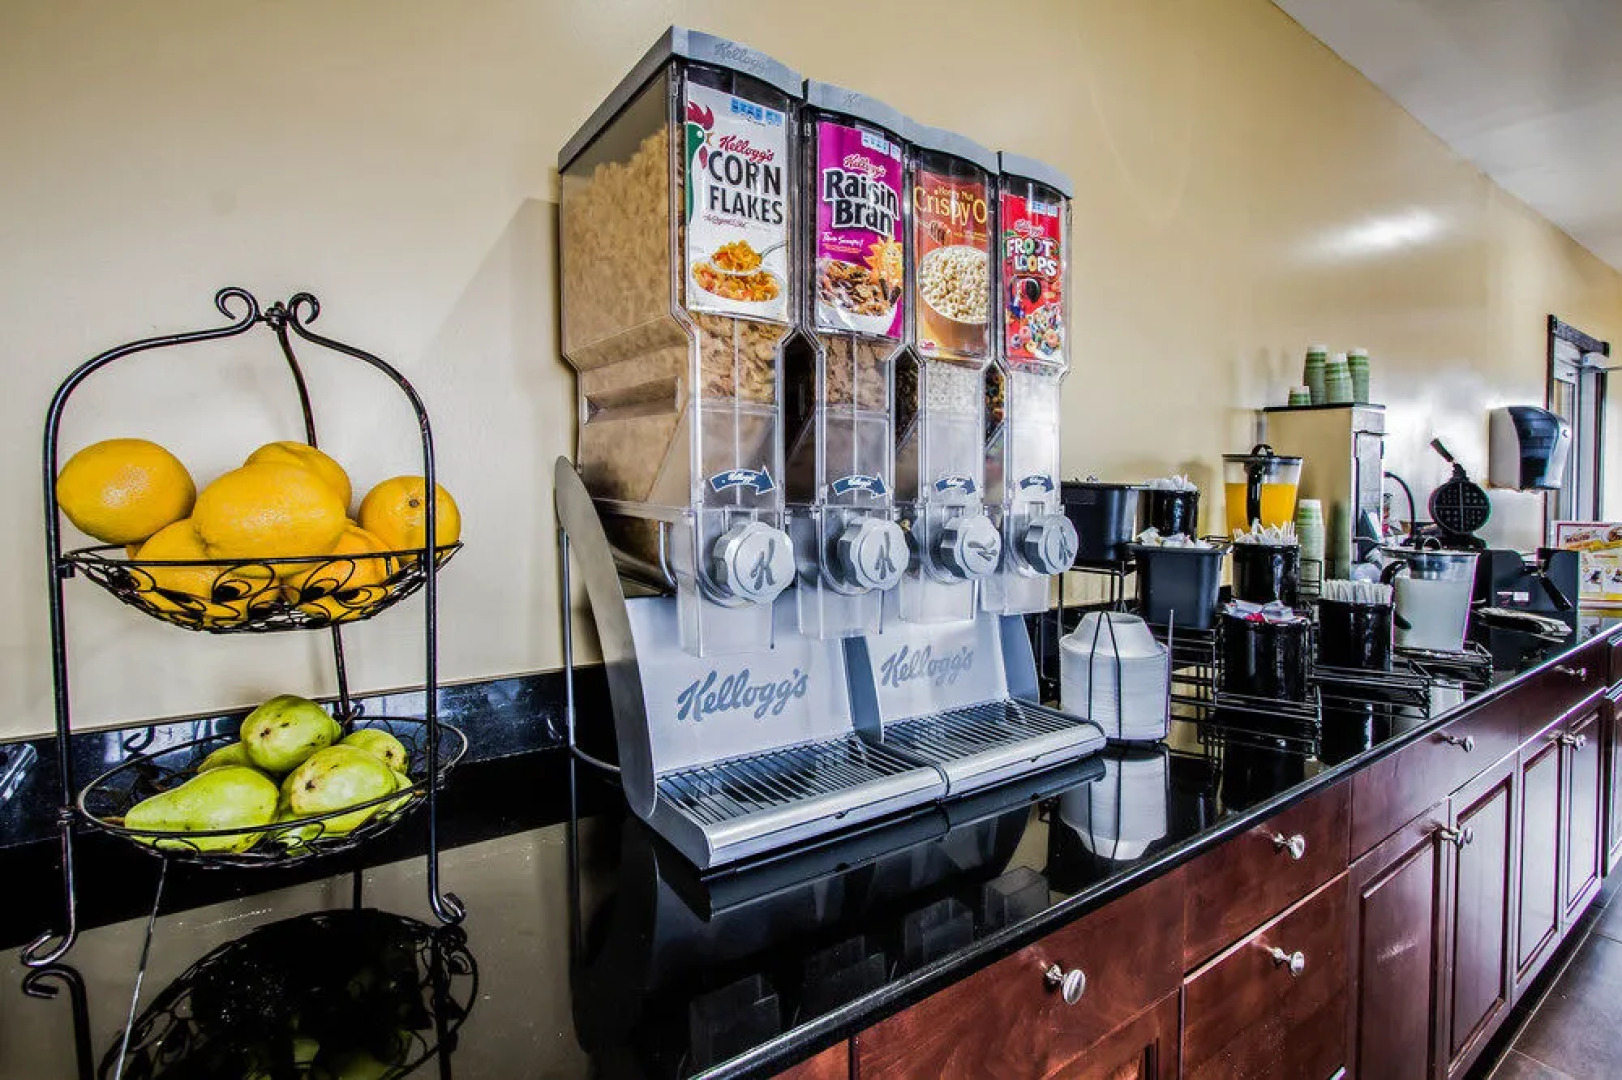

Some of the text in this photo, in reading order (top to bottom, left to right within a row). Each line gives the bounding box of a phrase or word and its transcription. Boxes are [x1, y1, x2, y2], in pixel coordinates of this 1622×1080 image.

[719, 135, 775, 164] Kellogg's
[708, 150, 782, 196] CORN
[709, 184, 783, 225] FLAKES
[823, 168, 899, 220] Raisin
[914, 186, 971, 226] Crispy
[832, 197, 895, 238] Bran
[1006, 237, 1054, 257] FROOT
[1014, 254, 1057, 277] LOOPS
[880, 645, 974, 688] Kellogg's
[677, 668, 809, 722] Kellogg's
